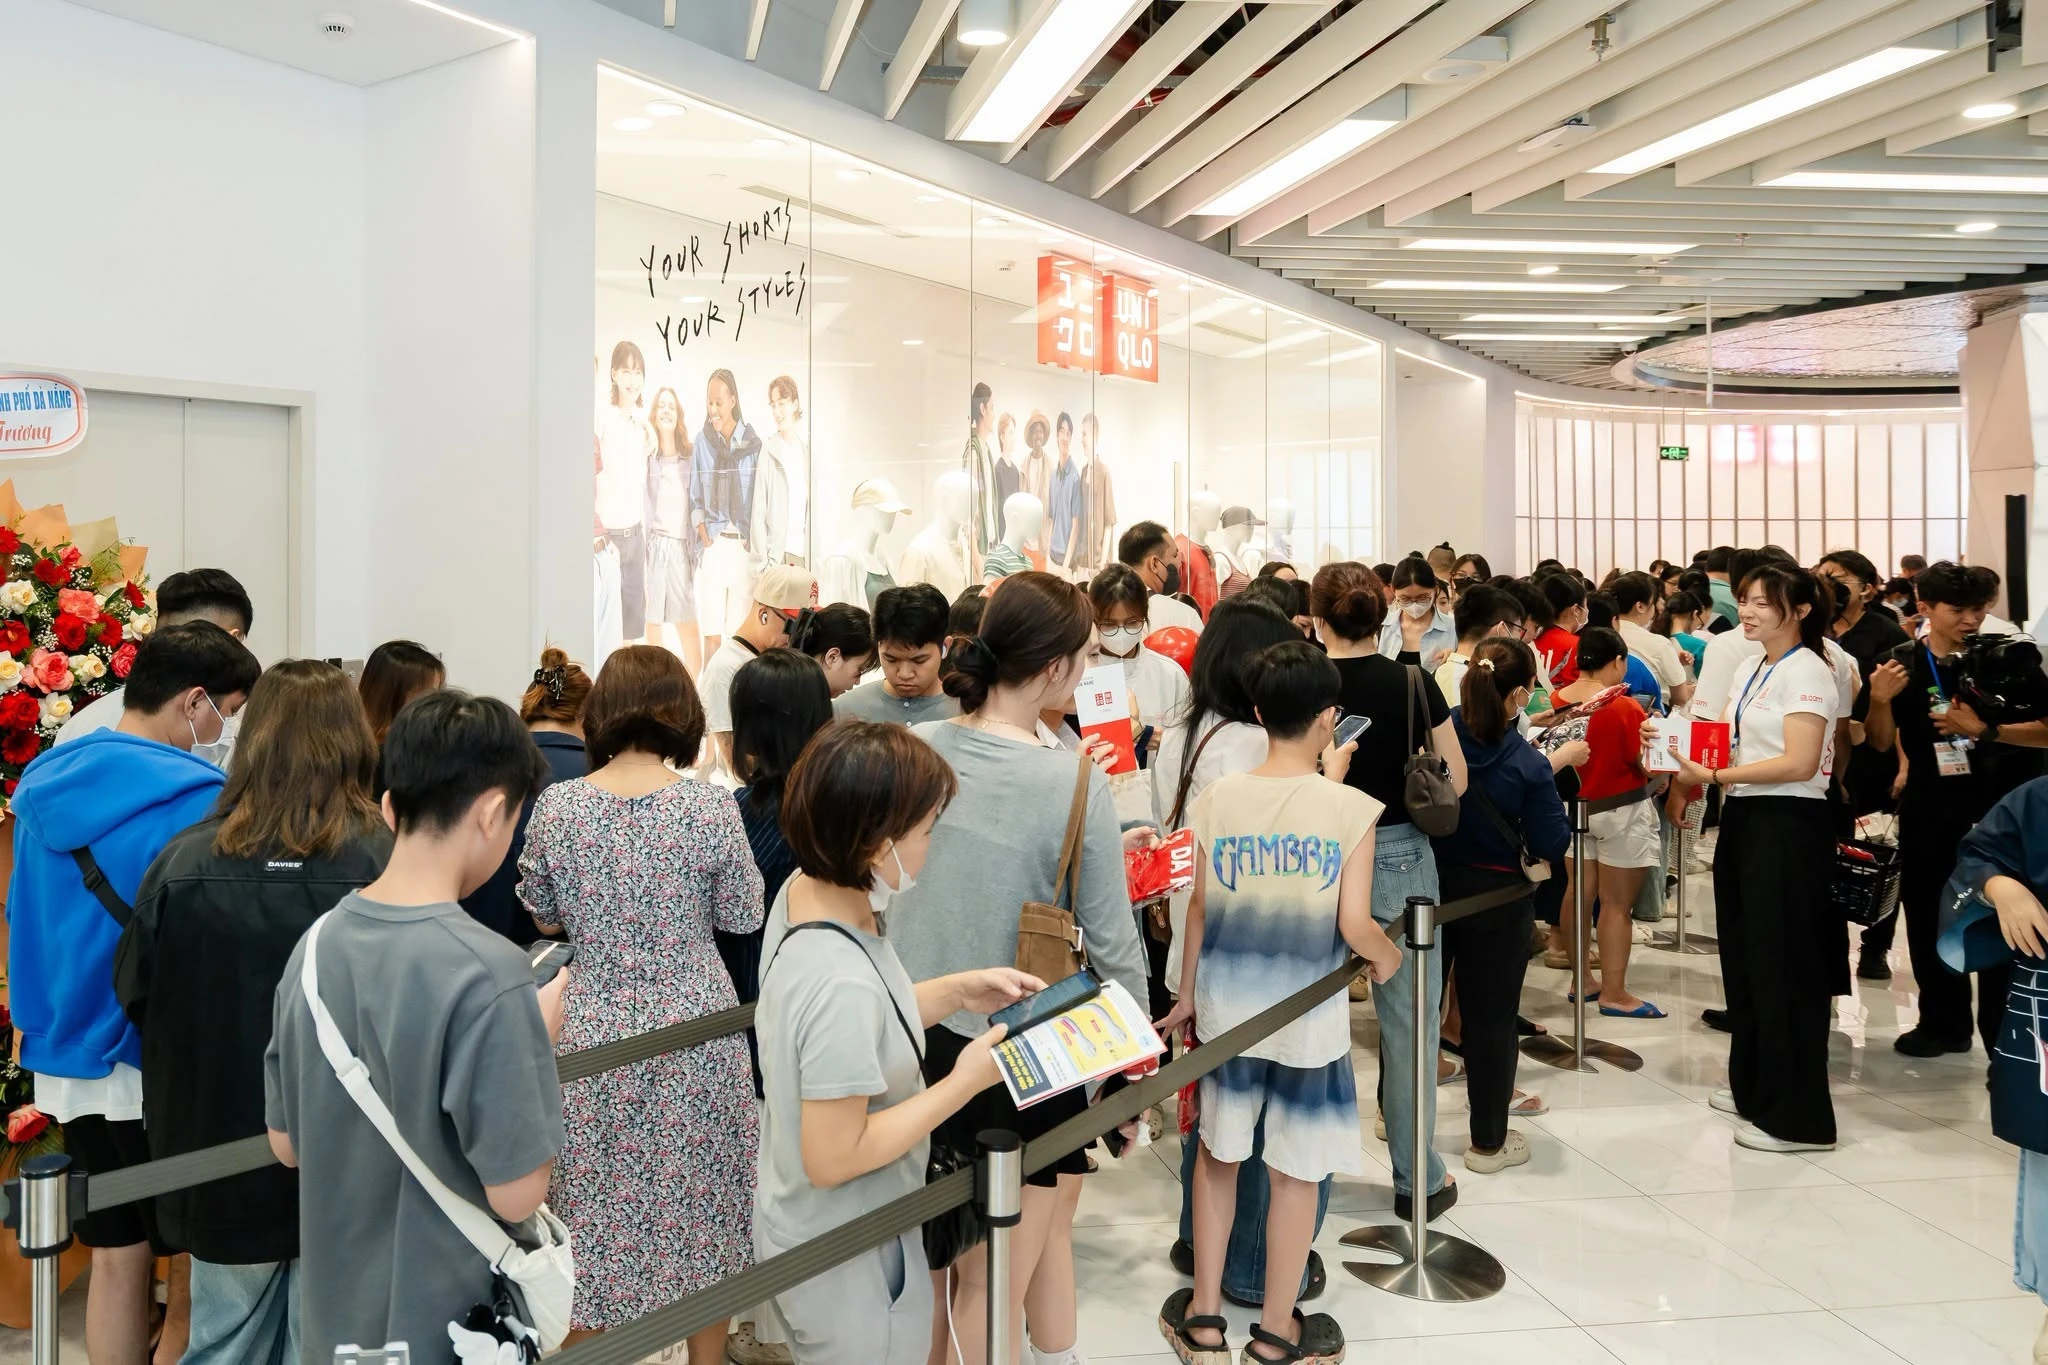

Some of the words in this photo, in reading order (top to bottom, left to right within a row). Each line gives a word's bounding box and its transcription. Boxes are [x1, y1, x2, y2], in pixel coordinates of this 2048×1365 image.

[640, 235, 703, 298] YOUR
[721, 198, 792, 284] SHORTS
[656, 300, 725, 361] YOUR
[736, 262, 806, 341] STYLES
[1117, 288, 1150, 330] UNI
[1117, 331, 1153, 370] QLO
[1212, 833, 1342, 893] GAMBBA
[1952, 887, 1973, 910] UNQLO
